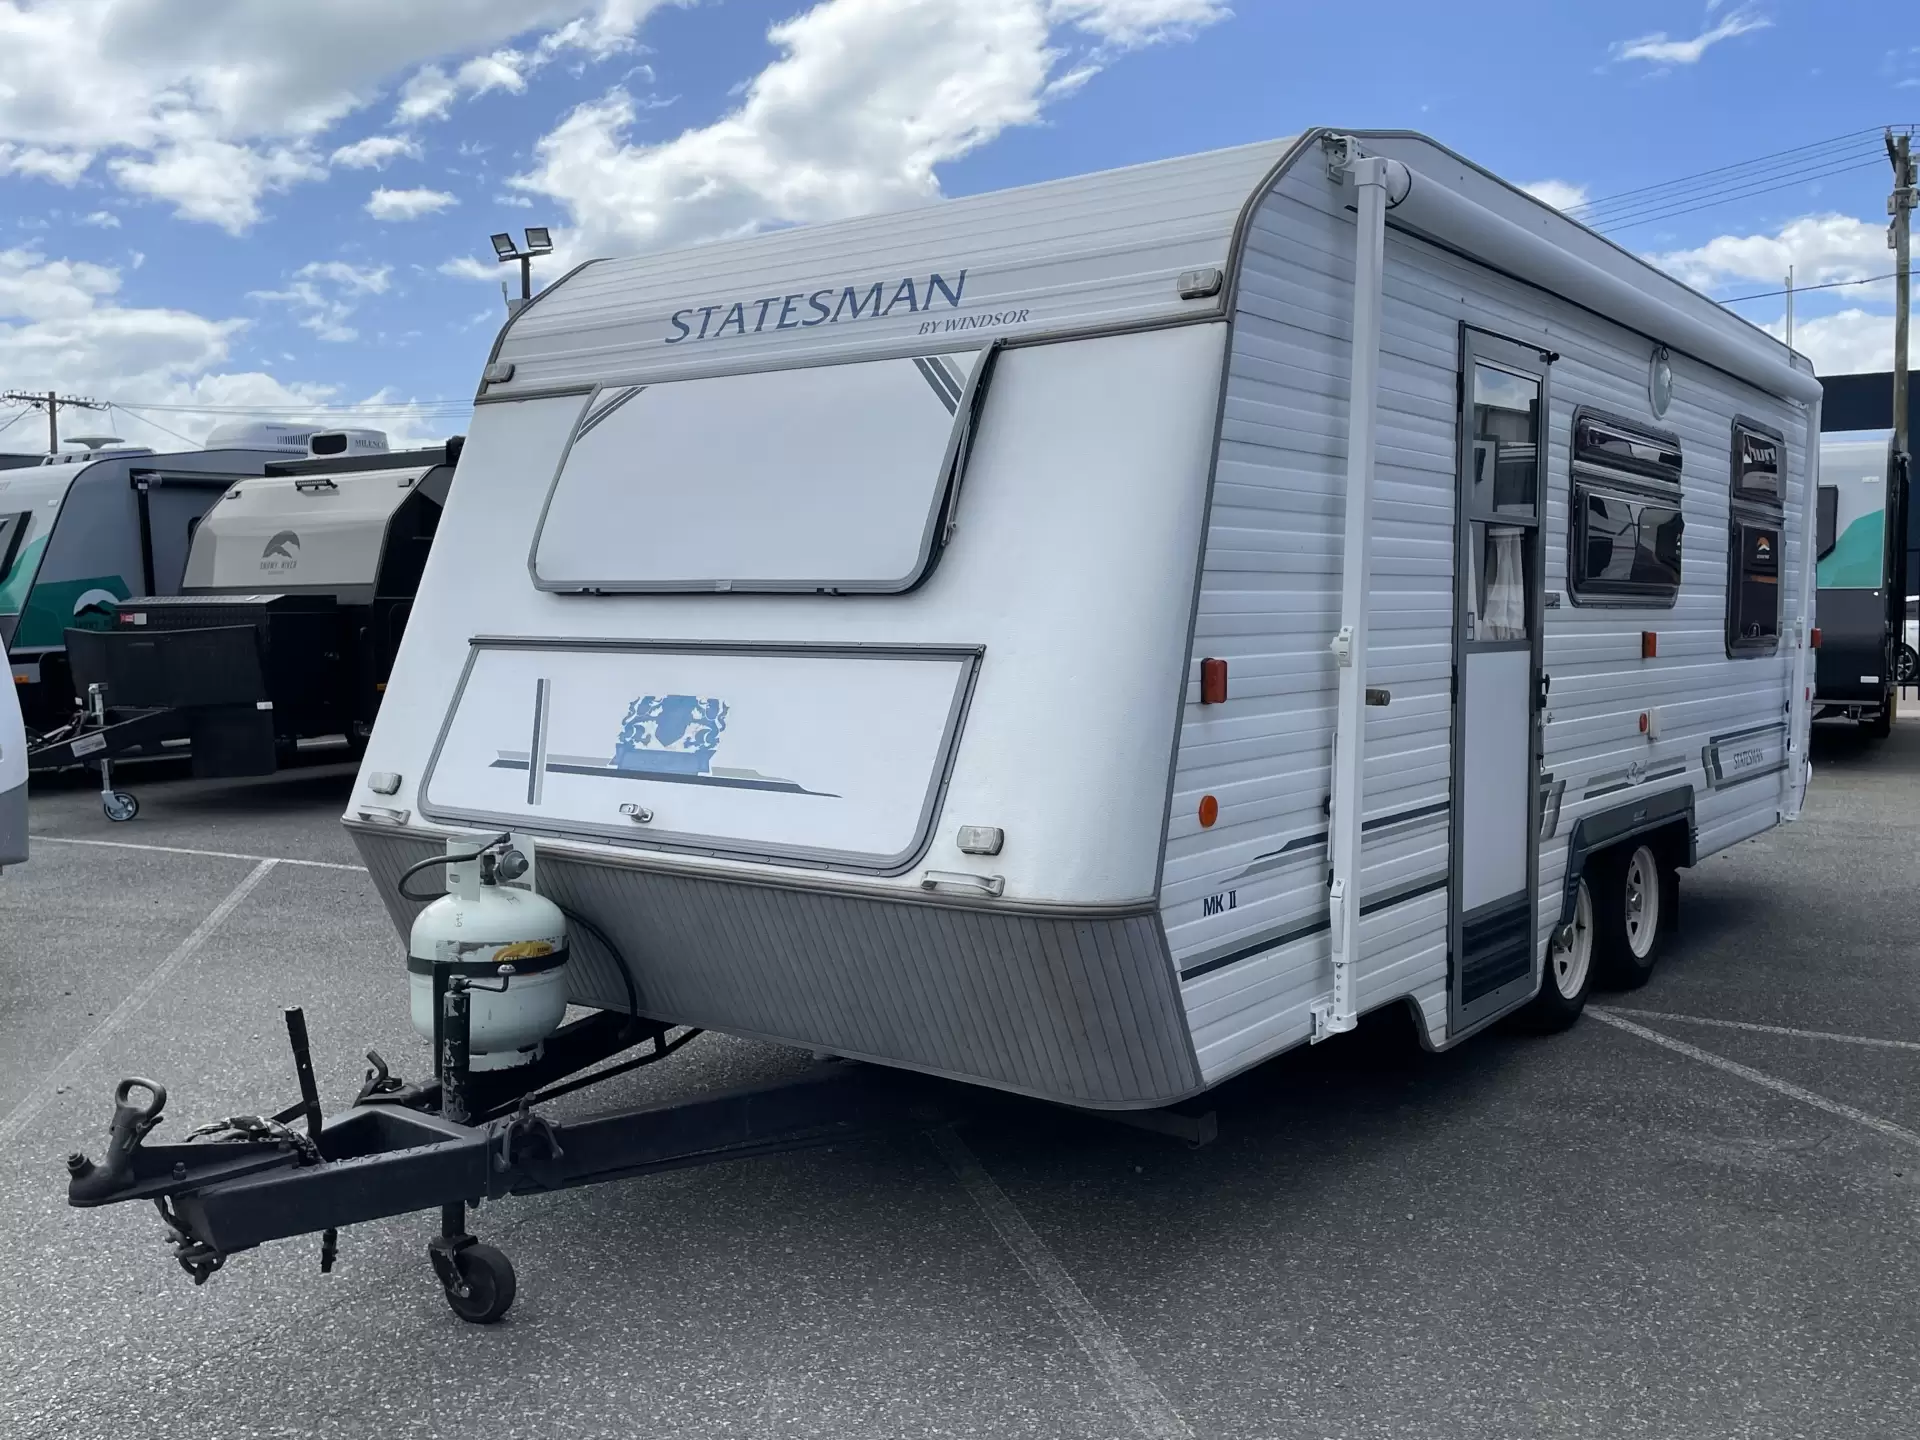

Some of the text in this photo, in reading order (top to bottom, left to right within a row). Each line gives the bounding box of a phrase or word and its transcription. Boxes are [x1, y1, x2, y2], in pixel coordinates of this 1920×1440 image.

[665, 269, 967, 343] STATESMAN
[918, 309, 1030, 335] BY WINDSOR
[1733, 748, 1764, 770] STATESMAN
[1203, 890, 1237, 917] MK II
